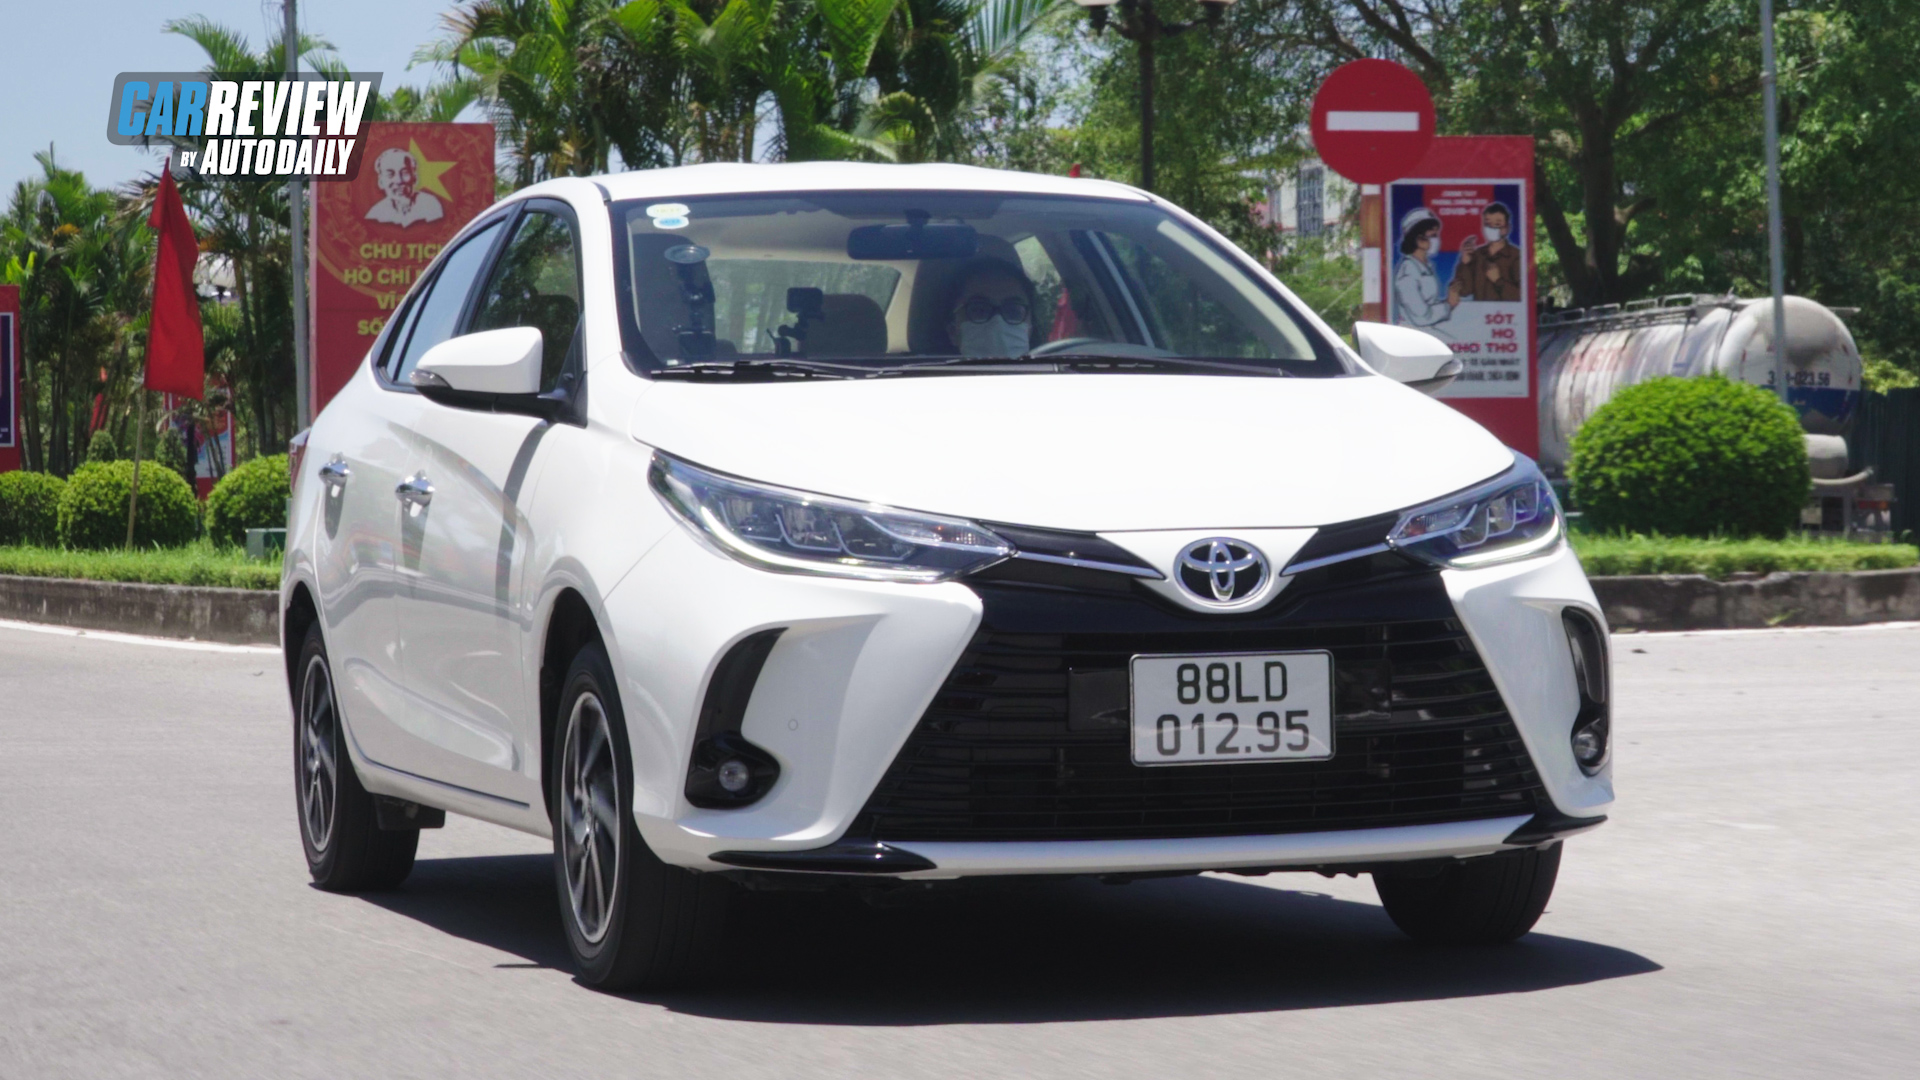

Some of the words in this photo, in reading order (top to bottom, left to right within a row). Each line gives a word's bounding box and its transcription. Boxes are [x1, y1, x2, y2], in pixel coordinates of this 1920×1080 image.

[377, 264, 411, 284] CHÍ
[1177, 661, 1288, 705] 88LD
[1156, 709, 1310, 756] 012.95
